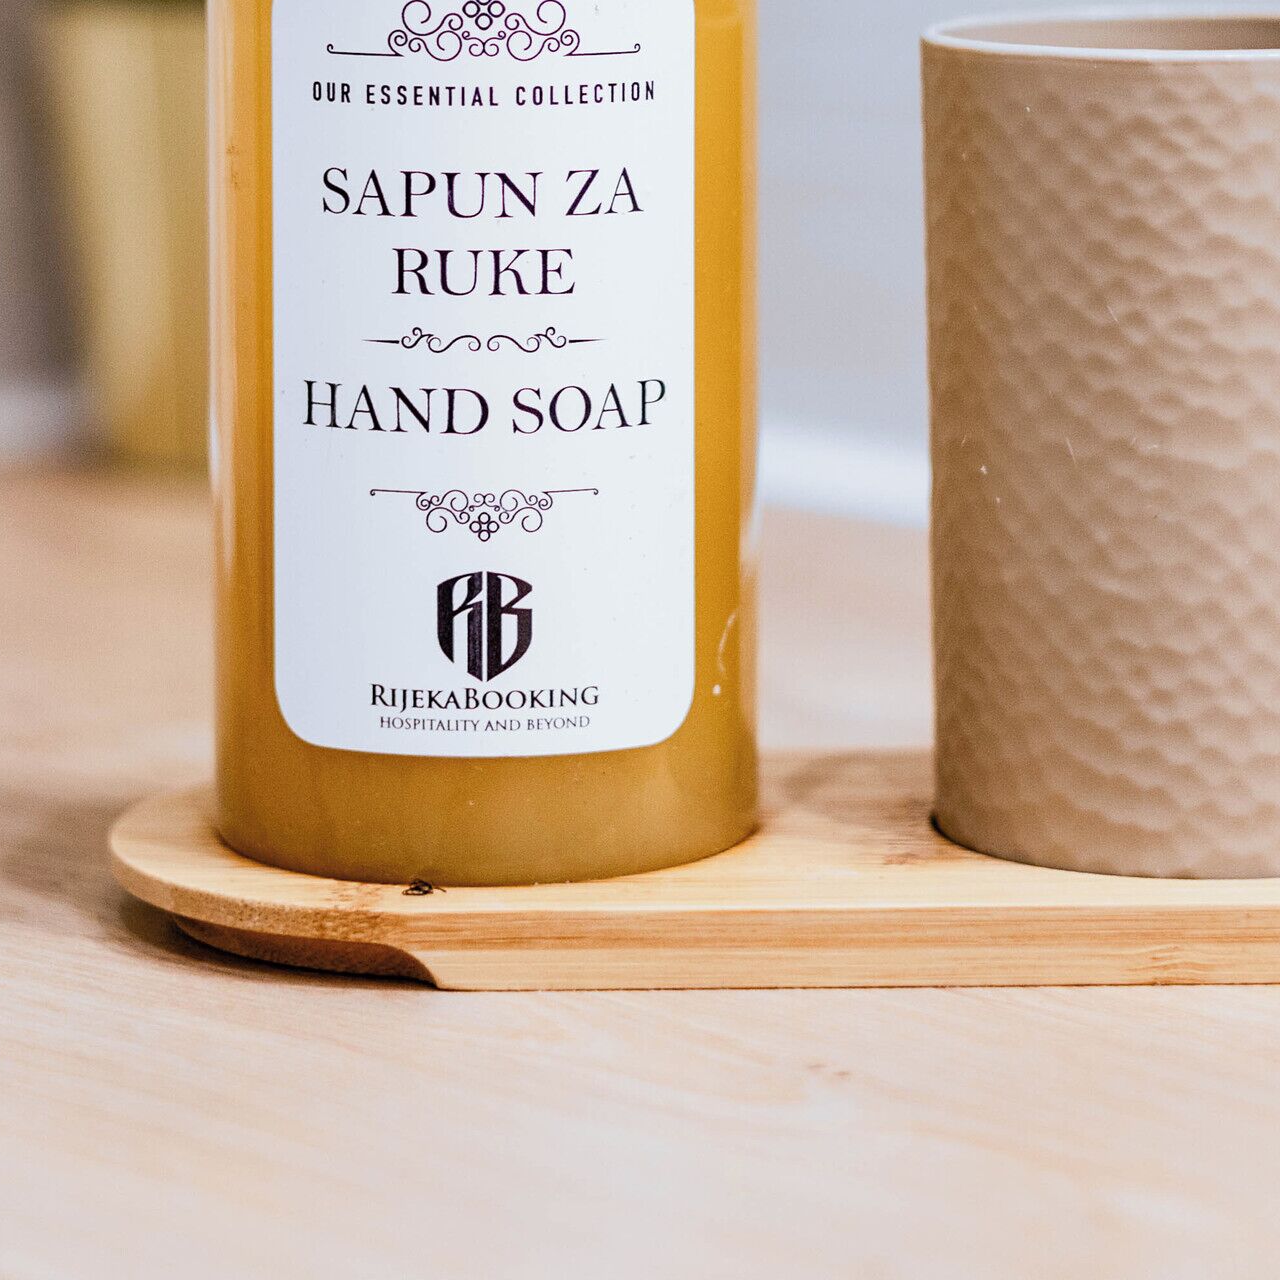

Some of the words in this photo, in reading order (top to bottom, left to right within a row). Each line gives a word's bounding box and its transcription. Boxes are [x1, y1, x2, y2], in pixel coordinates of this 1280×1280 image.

[313, 81, 351, 103] OUR
[366, 84, 498, 106] ESSENTIAL
[516, 81, 654, 106] COLLECTION
[322, 167, 543, 218] SAPUN
[565, 167, 644, 216] ZA
[391, 248, 575, 296] RUKE
[303, 380, 489, 435] HAND
[512, 379, 665, 434] SOAP
[380, 716, 479, 731] HOSPITALITY
[485, 720, 521, 731] AND
[527, 716, 590, 730] BEYOND
